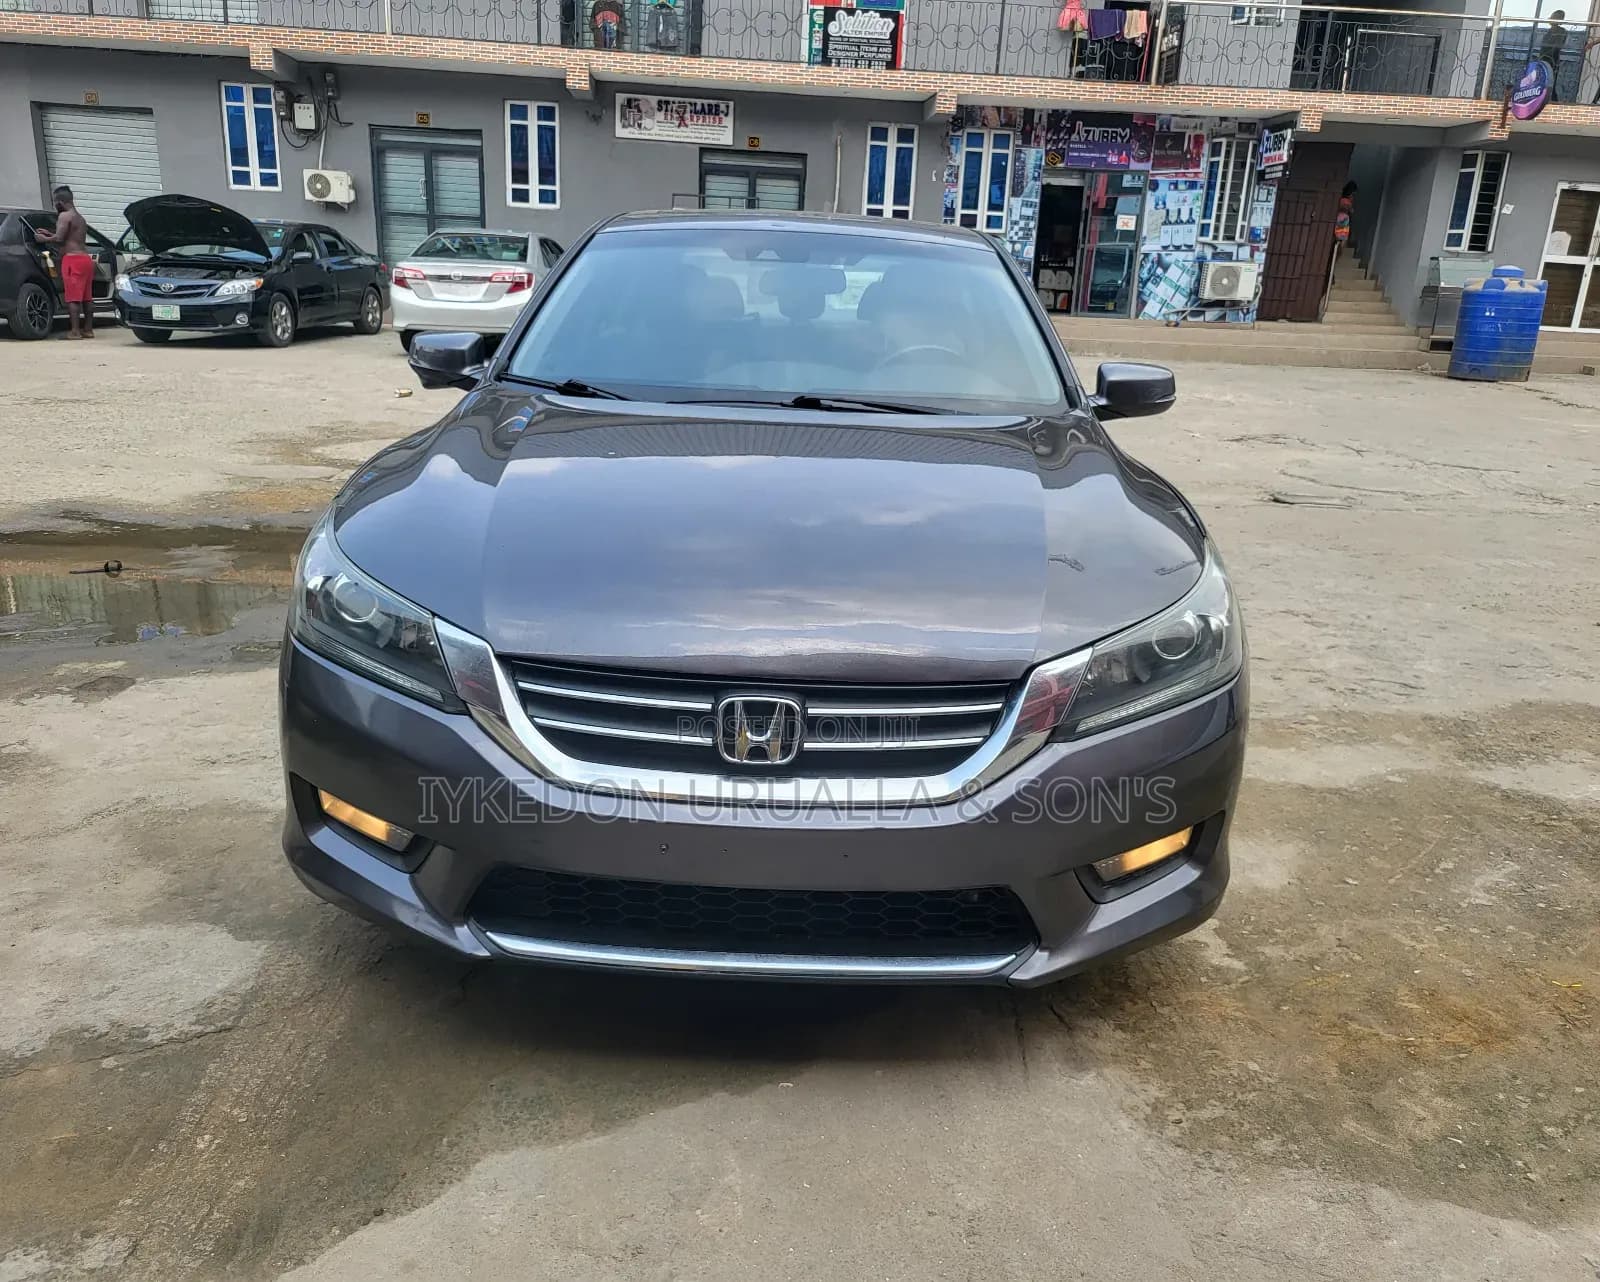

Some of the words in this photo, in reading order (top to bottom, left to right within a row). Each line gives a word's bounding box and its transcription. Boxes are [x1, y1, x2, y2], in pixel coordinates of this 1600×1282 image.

[829, 10, 894, 36] Solution
[828, 50, 858, 58] DESIGNER
[859, 51, 892, 59] PERFUMES
[657, 99, 730, 117] STCLARE-J
[418, 115, 429, 123] C5
[663, 112, 724, 125] ENRPRISE
